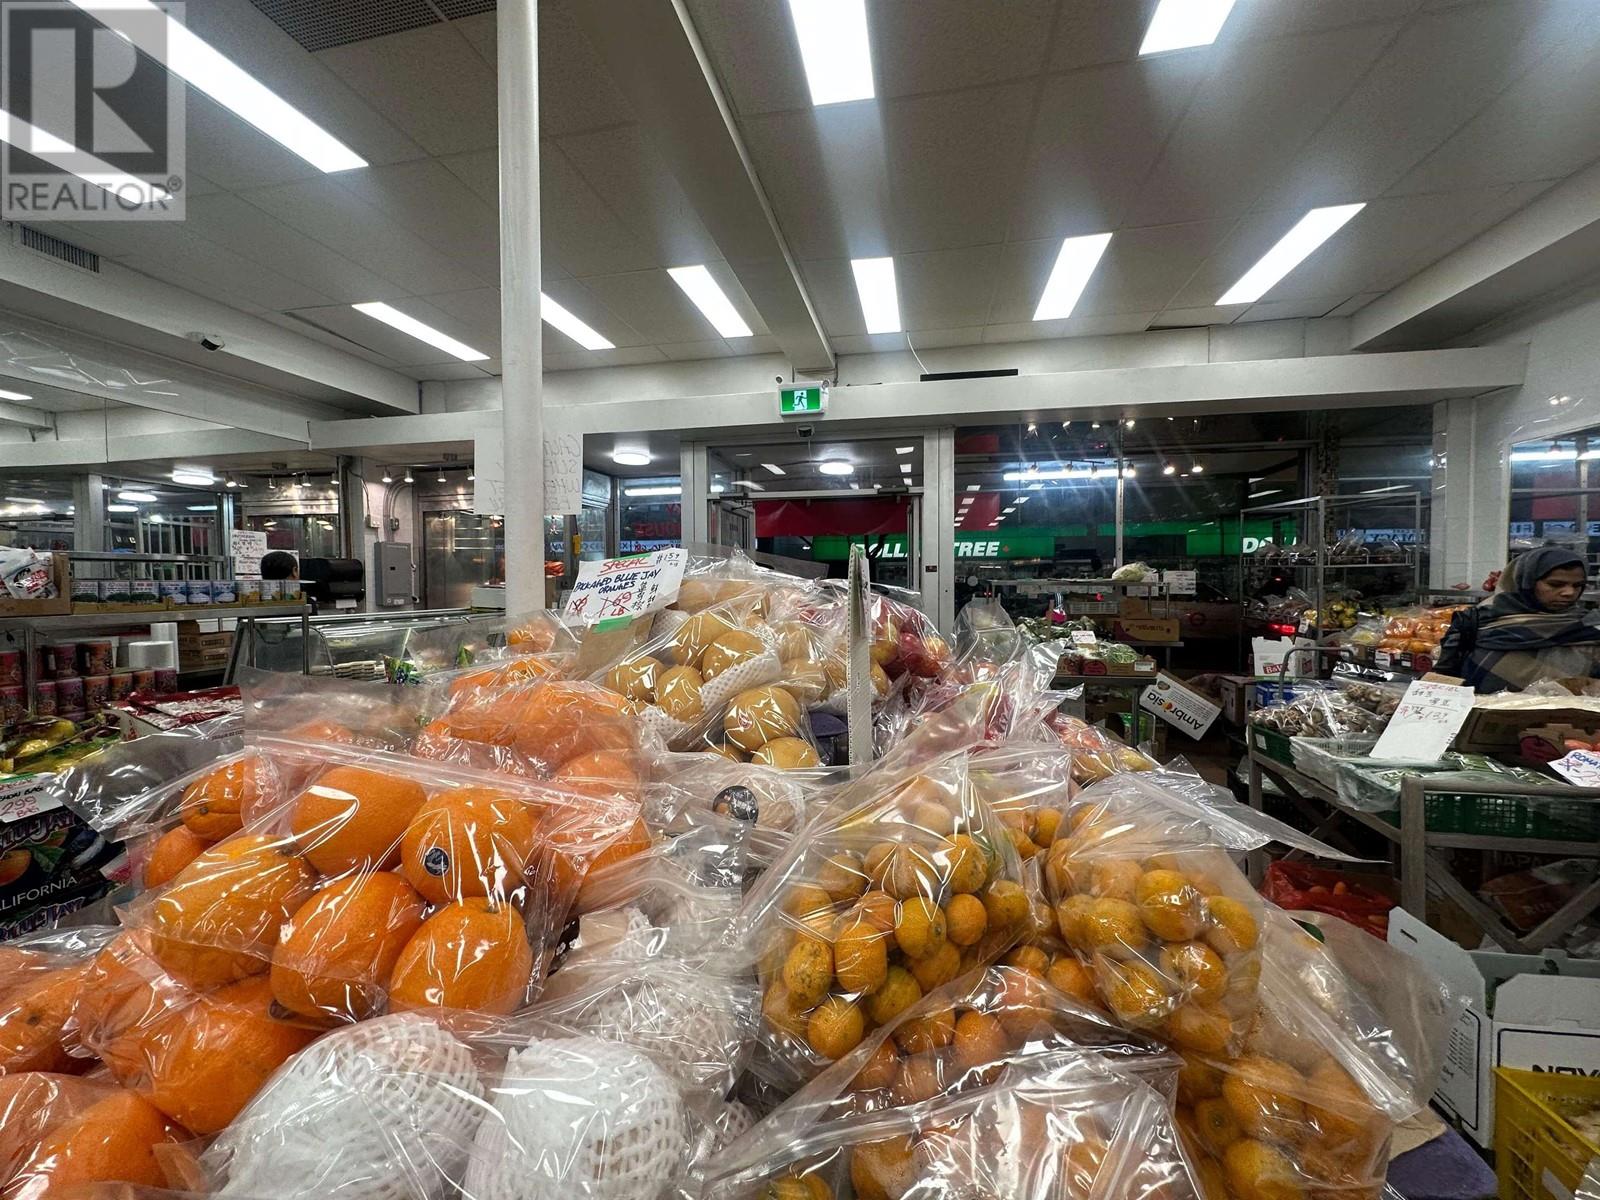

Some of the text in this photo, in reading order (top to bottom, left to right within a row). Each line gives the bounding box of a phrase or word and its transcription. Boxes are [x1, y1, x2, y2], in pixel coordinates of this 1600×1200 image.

[613, 572, 638, 584] BLUE
[640, 568, 662, 580] JAY
[1146, 691, 1204, 731] Ambrosia
[0, 875, 78, 911] LIFORNIA
